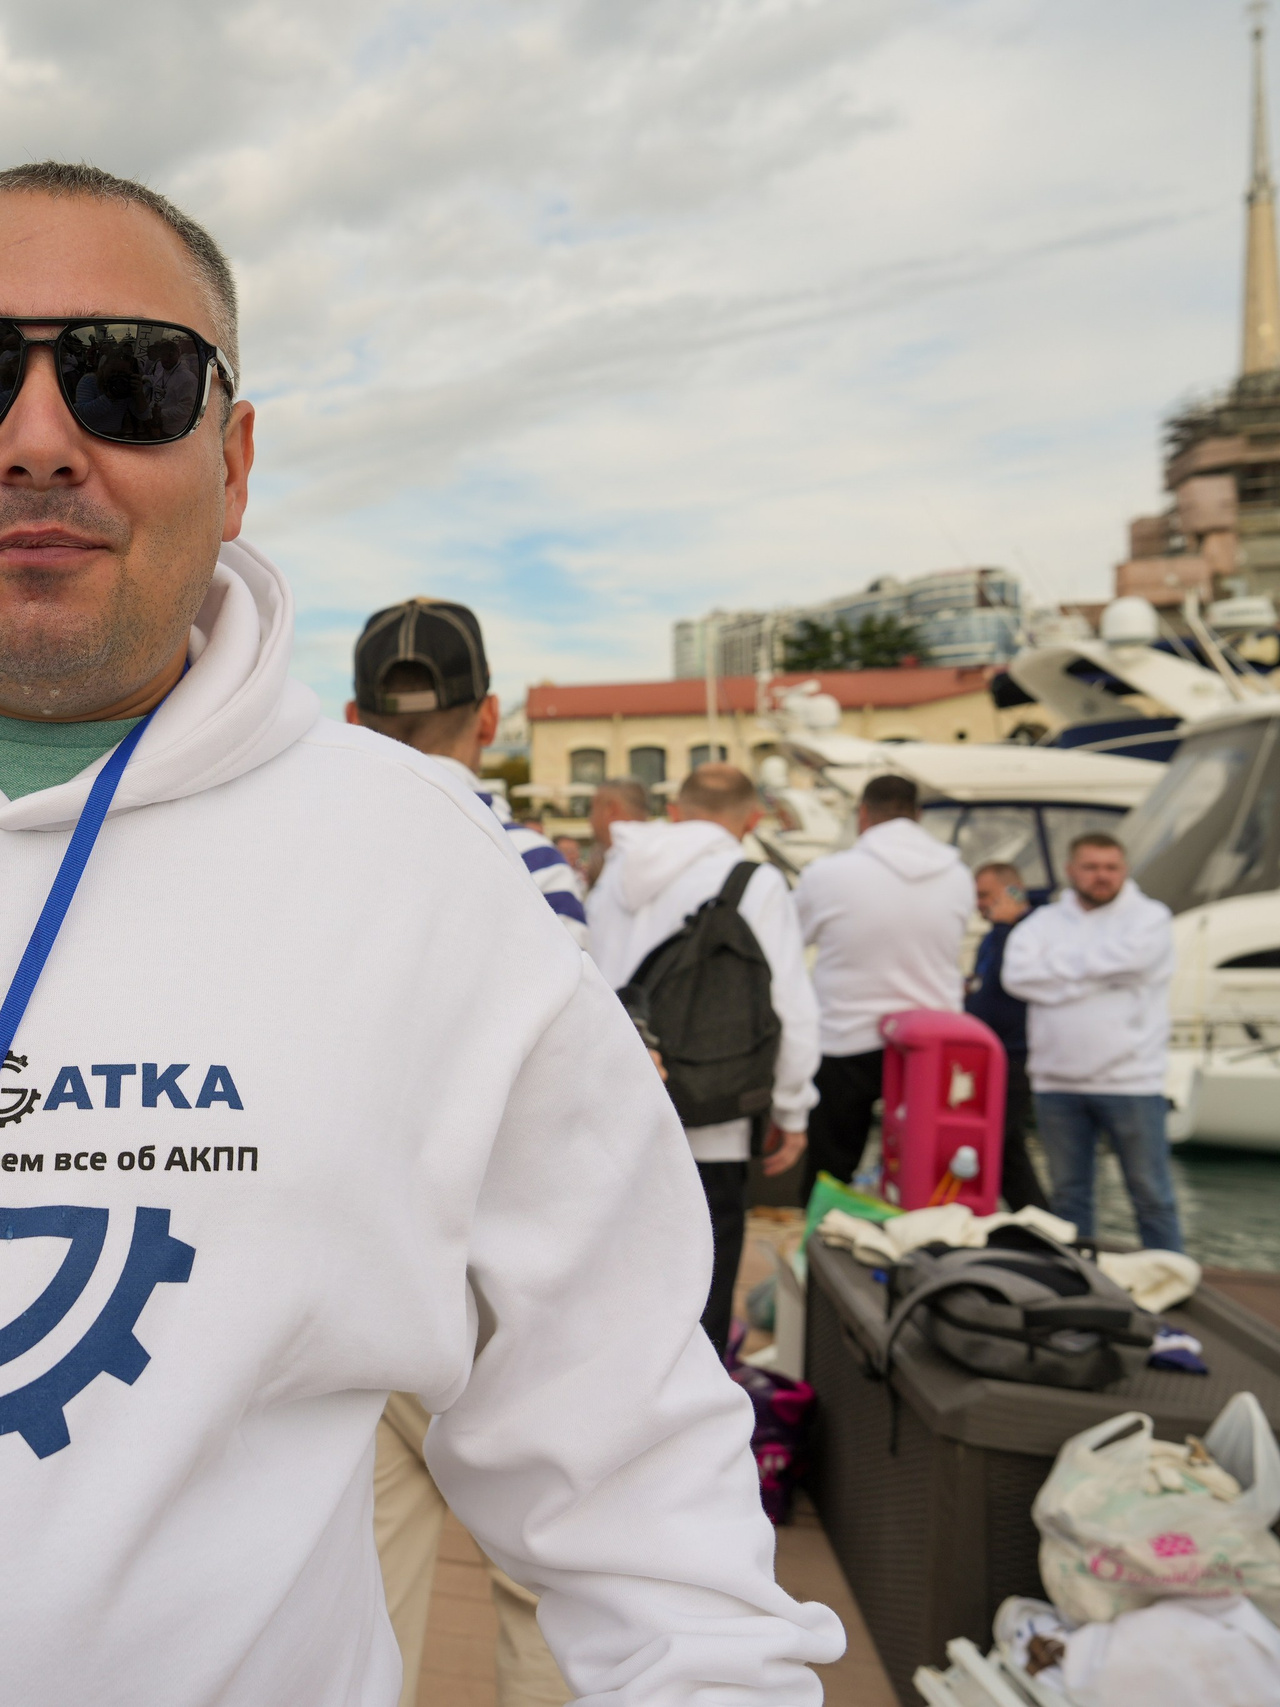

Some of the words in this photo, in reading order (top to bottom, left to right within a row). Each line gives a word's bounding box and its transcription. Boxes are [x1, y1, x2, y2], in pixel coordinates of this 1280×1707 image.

[54, 1152, 107, 1172] все
[117, 1145, 156, 1171] об
[164, 1146, 259, 1172] АКПП
